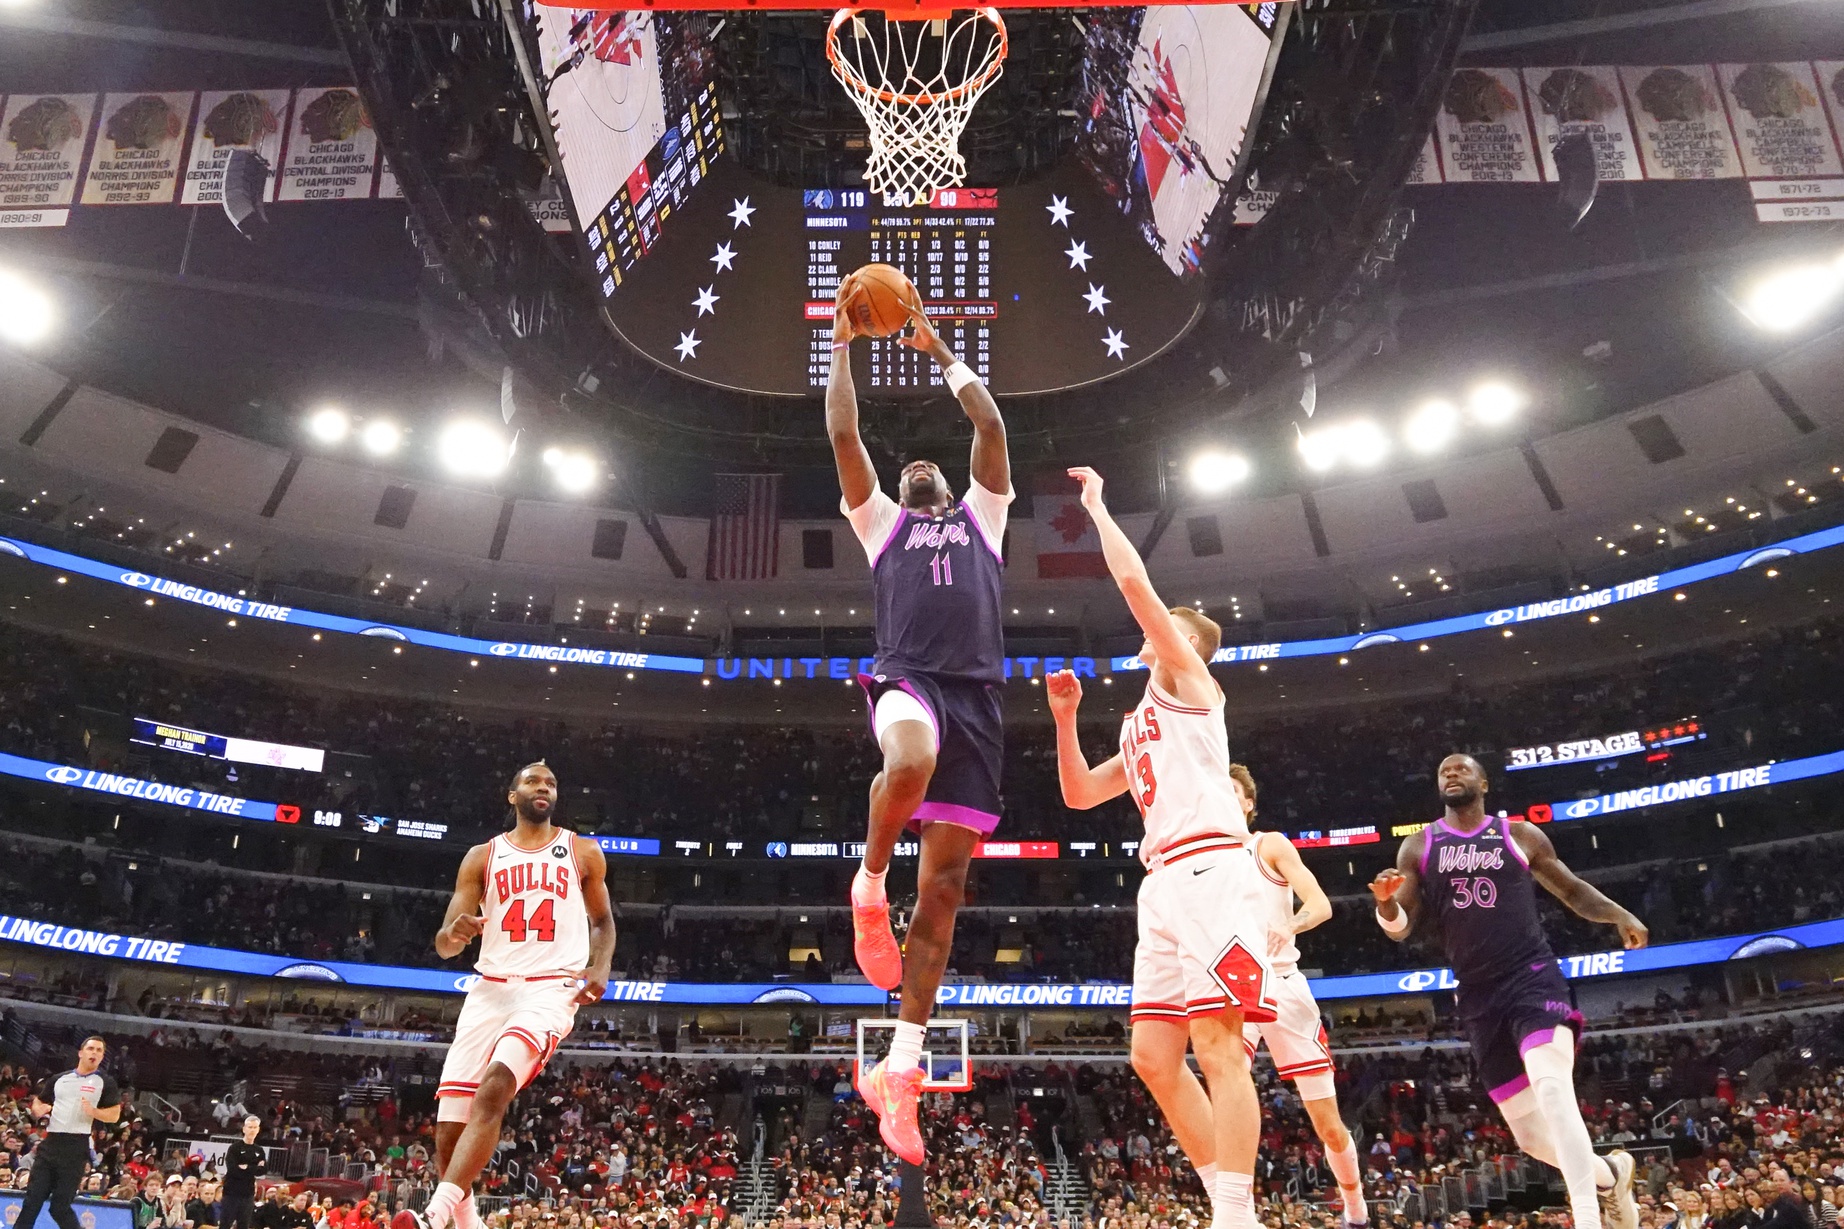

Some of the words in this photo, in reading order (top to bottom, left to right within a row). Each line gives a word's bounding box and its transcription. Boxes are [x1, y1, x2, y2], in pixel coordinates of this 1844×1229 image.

[1460, 124, 1508, 134] CHICAGO
[1448, 133, 1523, 143] BLACKHAWKS
[309, 144, 354, 154] CHICAGO
[1460, 143, 1515, 152] WESTERN
[15, 152, 60, 161] CHICAGO
[115, 150, 160, 160] CHICAGO
[294, 154, 366, 165] BLACKHAWKS
[1452, 152, 1526, 162] CONFERENCE
[0, 162, 70, 172] BLACKHAWKS
[99, 160, 170, 170] BLACKHAWKS
[1459, 161, 1522, 171] CHAMPIONS
[30, 171, 74, 181] DIVISION
[90, 172, 127, 181] NORRIS
[131, 170, 174, 180] DIVISION
[284, 166, 329, 177] CENTRAL
[332, 165, 373, 175] DIVISION
[1471, 171, 1514, 180] 2012-13
[0, 183, 60, 192] CHAMPIONS
[100, 181, 160, 191] CHAMPIONS
[296, 177, 356, 188] CHAMPIONS
[106, 192, 150, 202] 1992-93
[304, 189, 345, 198] 2012-13
[841, 192, 864, 207] 119
[940, 192, 956, 206] 90
[806, 218, 848, 227] MINNESOTA
[881, 218, 895, 226] 44/79
[924, 218, 938, 226] 14/33
[939, 218, 954, 226] 42.4%
[818, 241, 840, 250] CONLEY
[872, 241, 878, 250] 17
[931, 241, 941, 250] 1/3
[818, 253, 832, 262] REID
[928, 253, 943, 262] 10/17
[978, 253, 989, 262] 5/5
[808, 265, 816, 274] 22
[818, 265, 838, 274] CLARK
[930, 265, 940, 274] 2/3
[978, 265, 989, 274] 2/2
[818, 277, 841, 286] RANDLE
[978, 342, 988, 350] 2/2
[809, 365, 816, 374] 44
[872, 377, 879, 386] 23
[930, 377, 943, 386] 5/14
[904, 522, 970, 550] Wolves
[930, 552, 952, 586] 11
[150, 578, 244, 613] LINGLONG
[246, 601, 292, 622] TIRE
[1516, 588, 1612, 622] LINGLONG
[1615, 576, 1660, 602] TIRE
[518, 644, 604, 664] LINGLONG
[609, 652, 648, 668] TIRE
[1240, 643, 1282, 660] TIRE
[716, 657, 875, 679] UNITED
[1510, 748, 1554, 767] 312
[1558, 732, 1641, 761] STAGE
[82, 770, 192, 806] LINGLONG
[196, 791, 246, 816] TIRE
[1602, 776, 1712, 814] LINGLONG
[1716, 765, 1771, 792] TIRE
[398, 819, 410, 828] SAN
[410, 821, 425, 830] JOSE
[425, 823, 448, 832] SHARKS
[1392, 824, 1420, 836] POINTS
[396, 828, 422, 837] ANAHEIM
[423, 830, 442, 839] DUCKS
[1329, 826, 1376, 837] TIMBERWOLVES
[602, 839, 638, 850] CLUB
[1329, 837, 1350, 845] BULLS
[790, 843, 838, 856] MINNESOTA
[894, 842, 918, 856] 5:51
[984, 844, 1020, 856] CHICAGO
[1438, 844, 1504, 873] Wolves
[494, 862, 569, 904] BULLS
[1451, 877, 1497, 908] 30
[502, 899, 556, 942] 44
[0, 915, 122, 955] LINGLONG
[122, 938, 186, 964] TIRE
[1568, 950, 1625, 978] TIRE
[614, 981, 666, 1002] TIRE
[958, 985, 1074, 1004] LINGLONG
[1078, 985, 1132, 1004] TIRE
